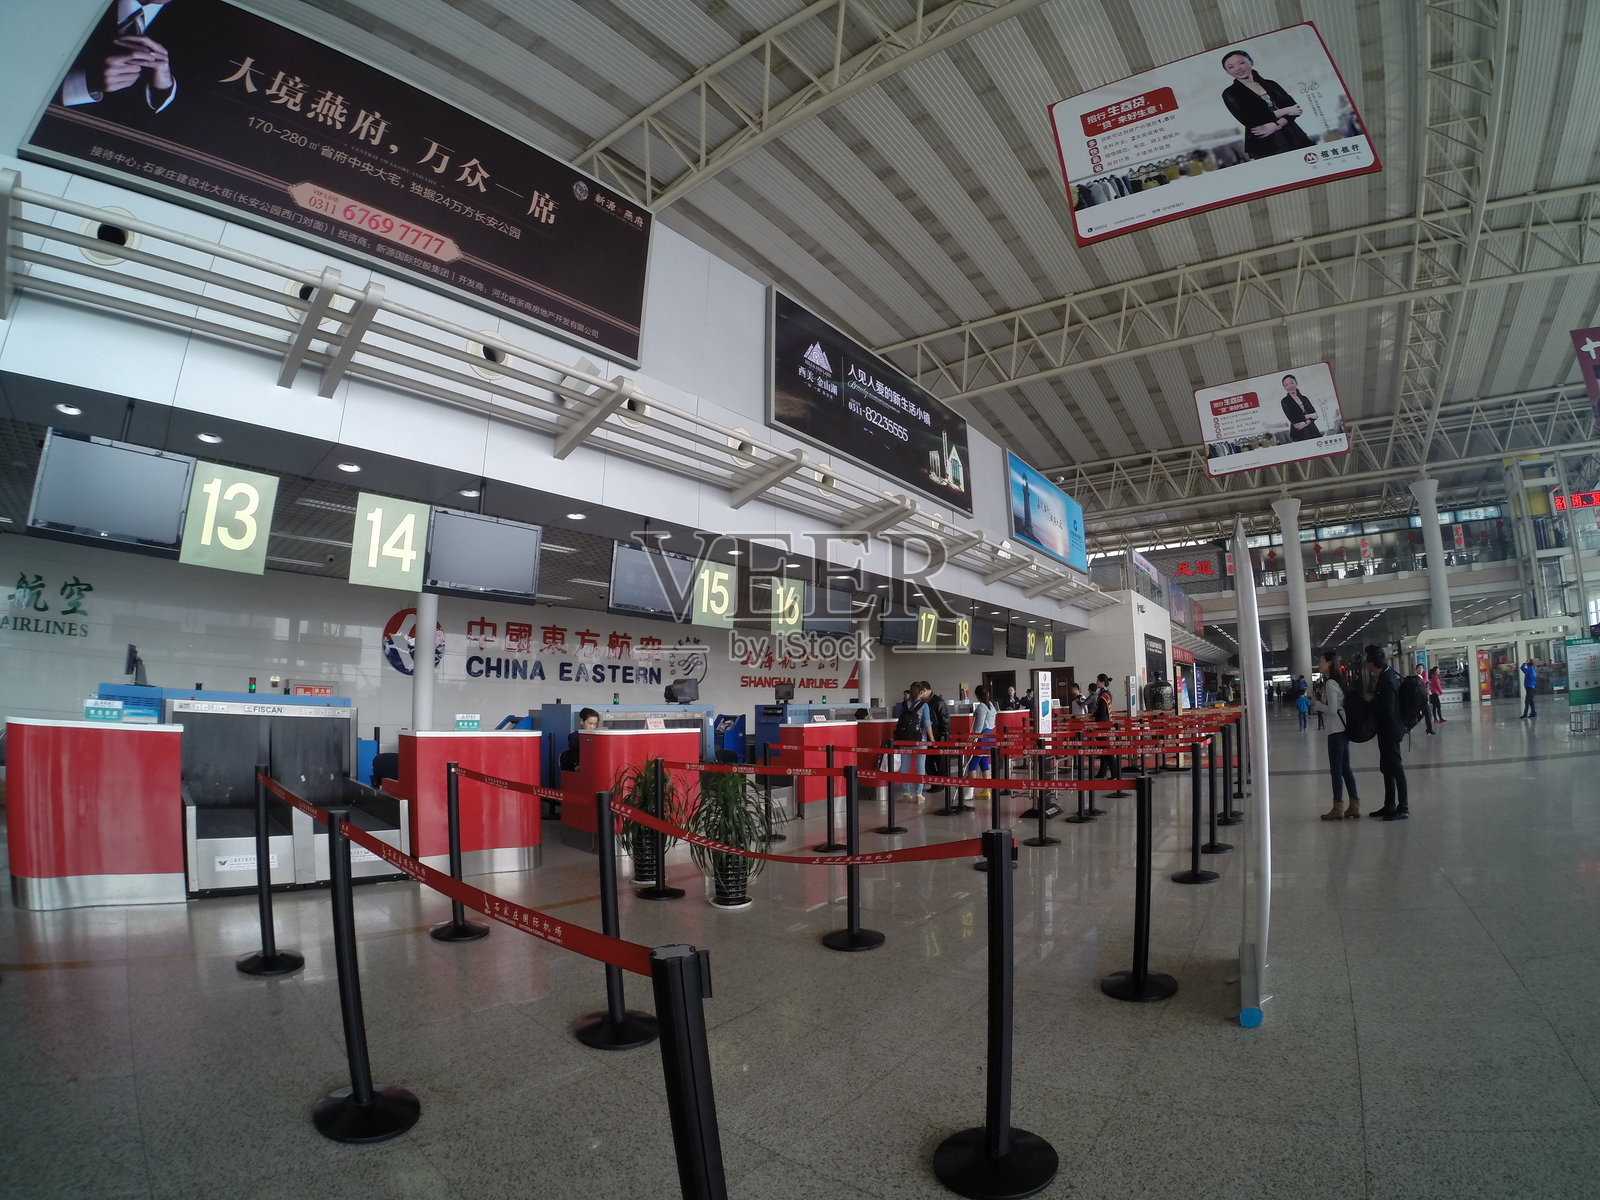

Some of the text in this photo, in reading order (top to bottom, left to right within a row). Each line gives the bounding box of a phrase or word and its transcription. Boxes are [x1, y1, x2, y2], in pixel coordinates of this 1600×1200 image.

[308, 196, 445, 255] 0311 6769 7777
[200, 477, 260, 552] 13
[366, 506, 418, 573] 14
[1175, 560, 1214, 577] 足道
[8, 572, 94, 616] 航空
[699, 568, 730, 617] 15
[775, 585, 801, 626] 16
[0, 615, 89, 638] AIRLINES
[920, 612, 936, 643] 17
[957, 617, 970, 647] 18
[1027, 632, 1036, 655] 19
[1044, 635, 1053, 656] 20
[466, 654, 662, 686] CHINA EASTERN
[740, 676, 839, 689] SHANGHAI AIRLINES
[253, 705, 284, 715] FISCAN
[494, 902, 563, 937] 石家庄国际机场
